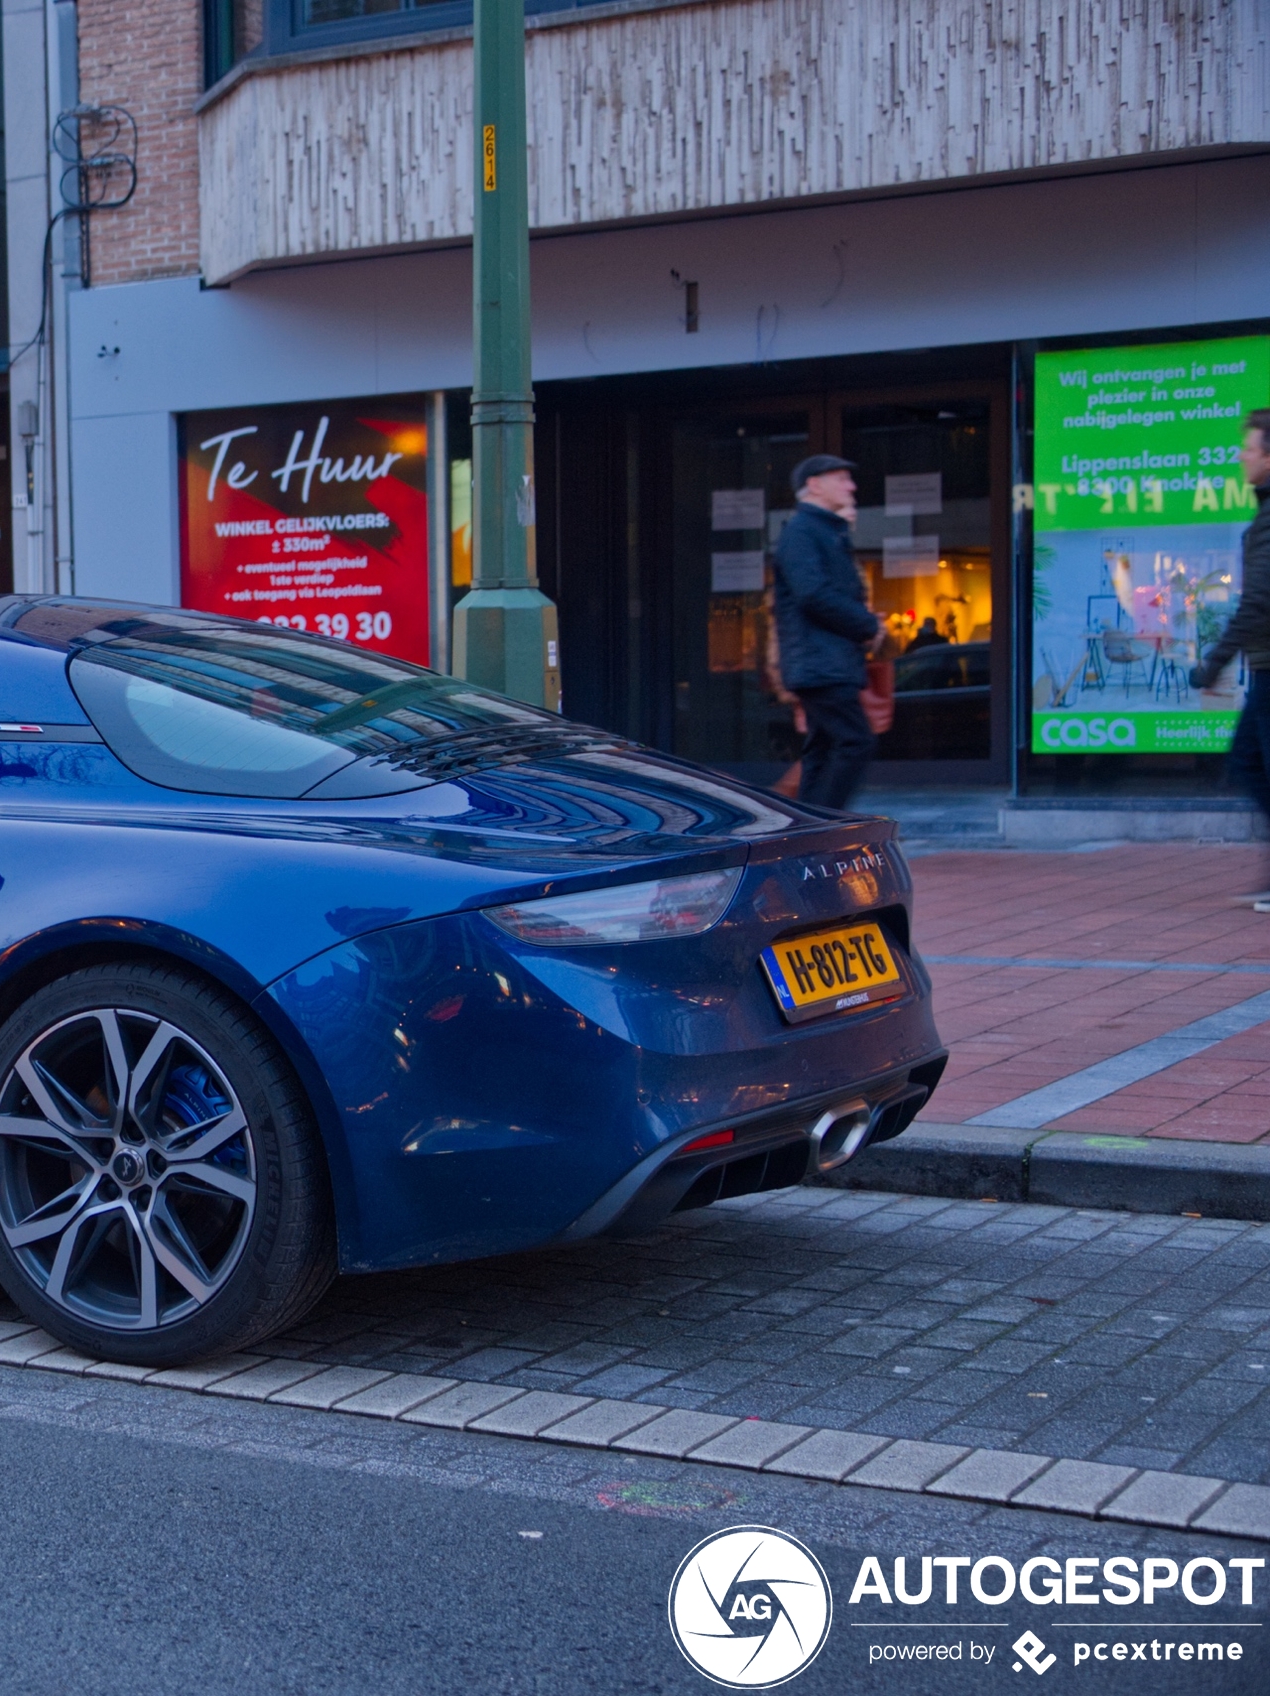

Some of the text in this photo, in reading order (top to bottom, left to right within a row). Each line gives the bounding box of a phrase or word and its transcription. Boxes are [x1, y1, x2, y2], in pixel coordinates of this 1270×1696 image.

[485, 126, 495, 189] 2614
[1059, 359, 1246, 388] Wij ontvangen je met
[1087, 386, 1216, 409] plezier in onze
[1063, 401, 1241, 430] nabijgelegen winkel
[200, 415, 403, 503] Te Huur
[1061, 446, 1242, 477] Lippenslaan 332
[1076, 471, 1226, 497] 8300 Knokke
[215, 519, 274, 538] WINKEL
[245, 560, 296, 574] eventueel
[297, 556, 368, 573] mogelijkheid
[232, 590, 252, 602] ook
[254, 588, 297, 604] toegang
[298, 587, 316, 599] via
[316, 584, 383, 602] Leopoldlaan
[269, 573, 335, 588] 1ste verdiep
[355, 611, 393, 641] 30
[1042, 717, 1136, 748] casa
[802, 852, 886, 882] ALPINE
[786, 932, 888, 996] H-812-TG
[776, 984, 791, 1000] NL
